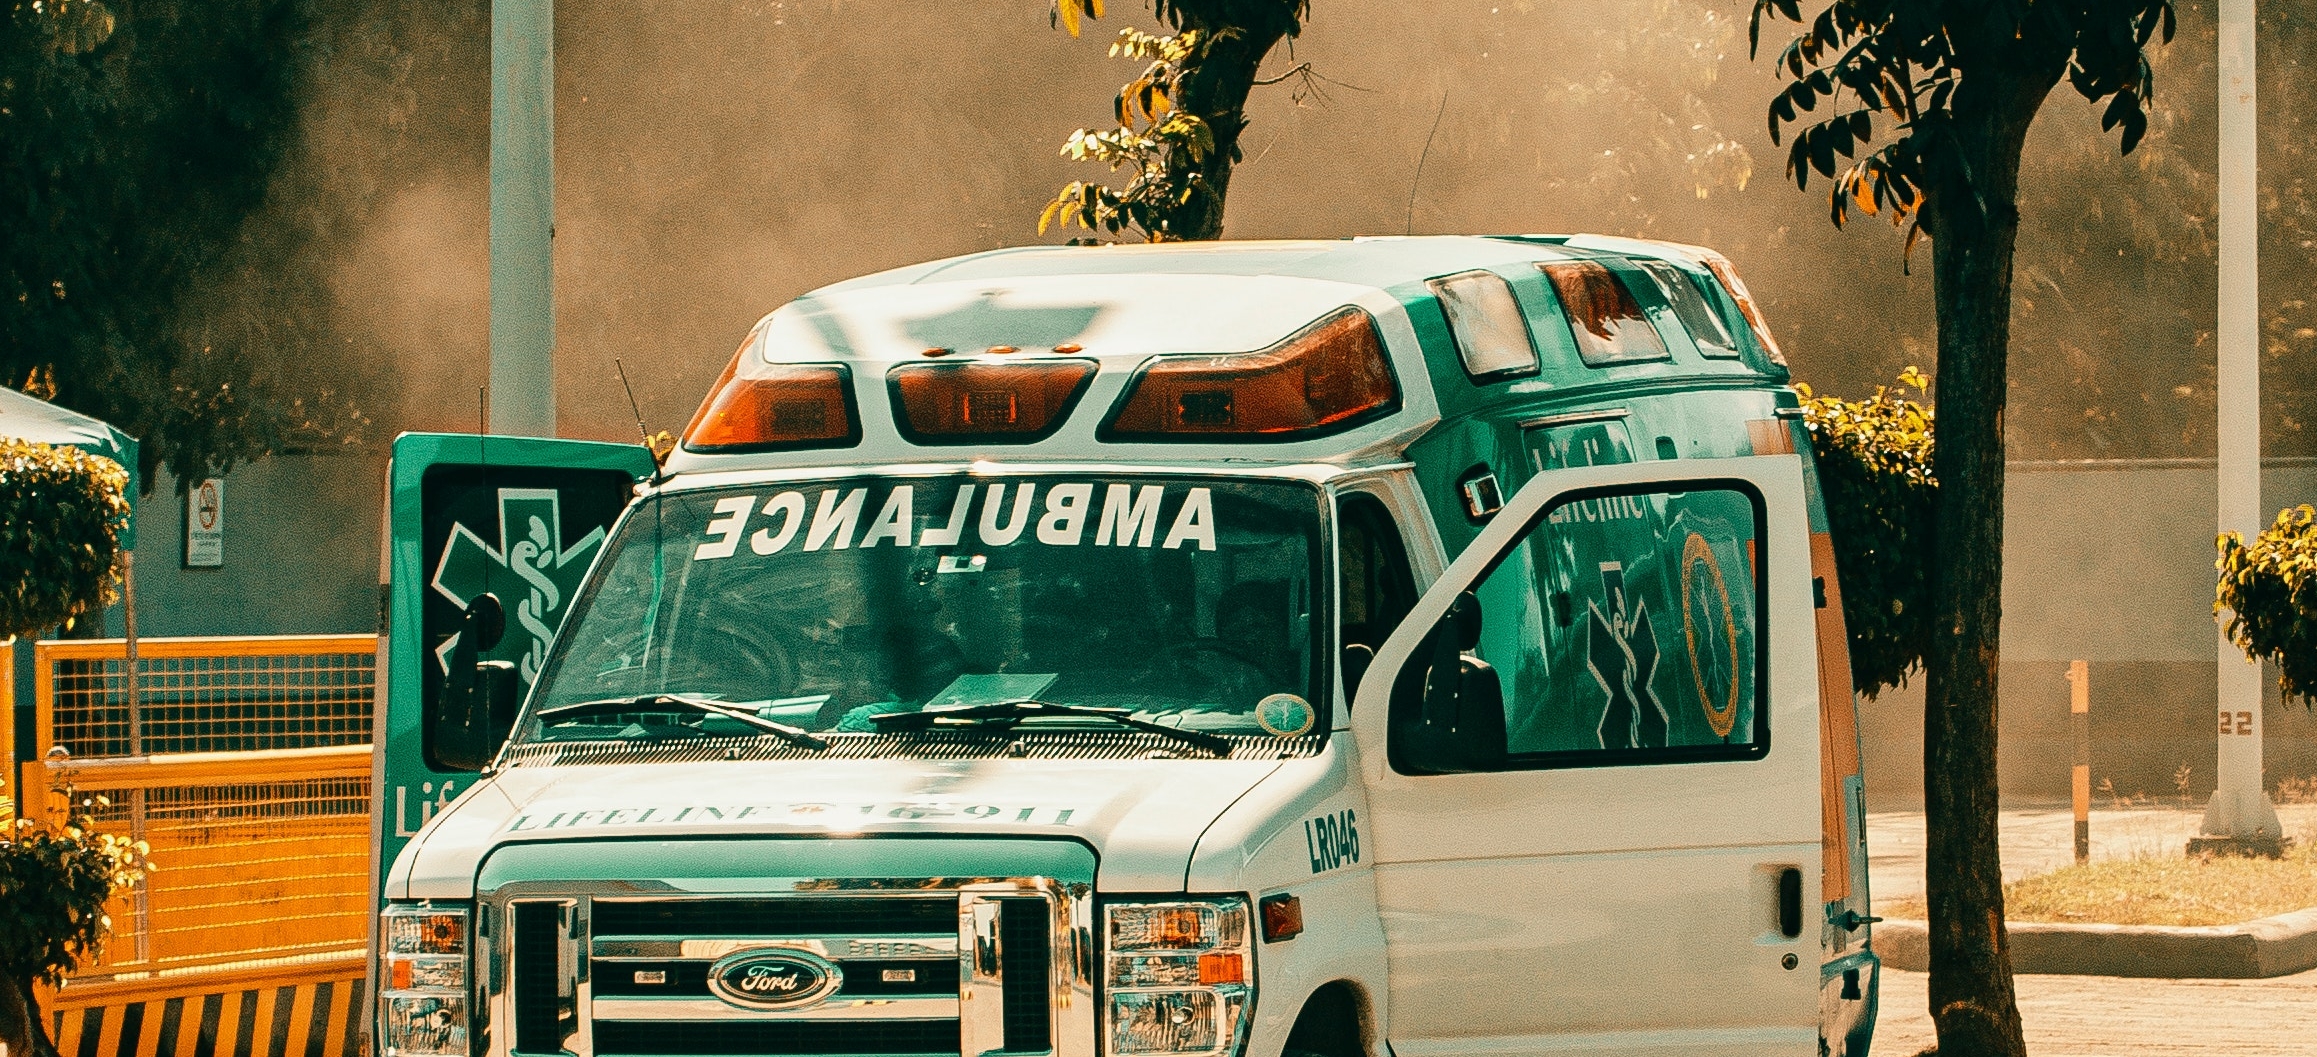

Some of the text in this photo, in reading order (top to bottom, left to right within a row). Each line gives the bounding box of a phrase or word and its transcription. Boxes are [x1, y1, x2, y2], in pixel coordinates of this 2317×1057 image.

[2219, 711, 2252, 735] 22
[507, 806, 771, 833] LIFELINE
[1304, 808, 1360, 874] LR046
[741, 965, 798, 991] Ford
